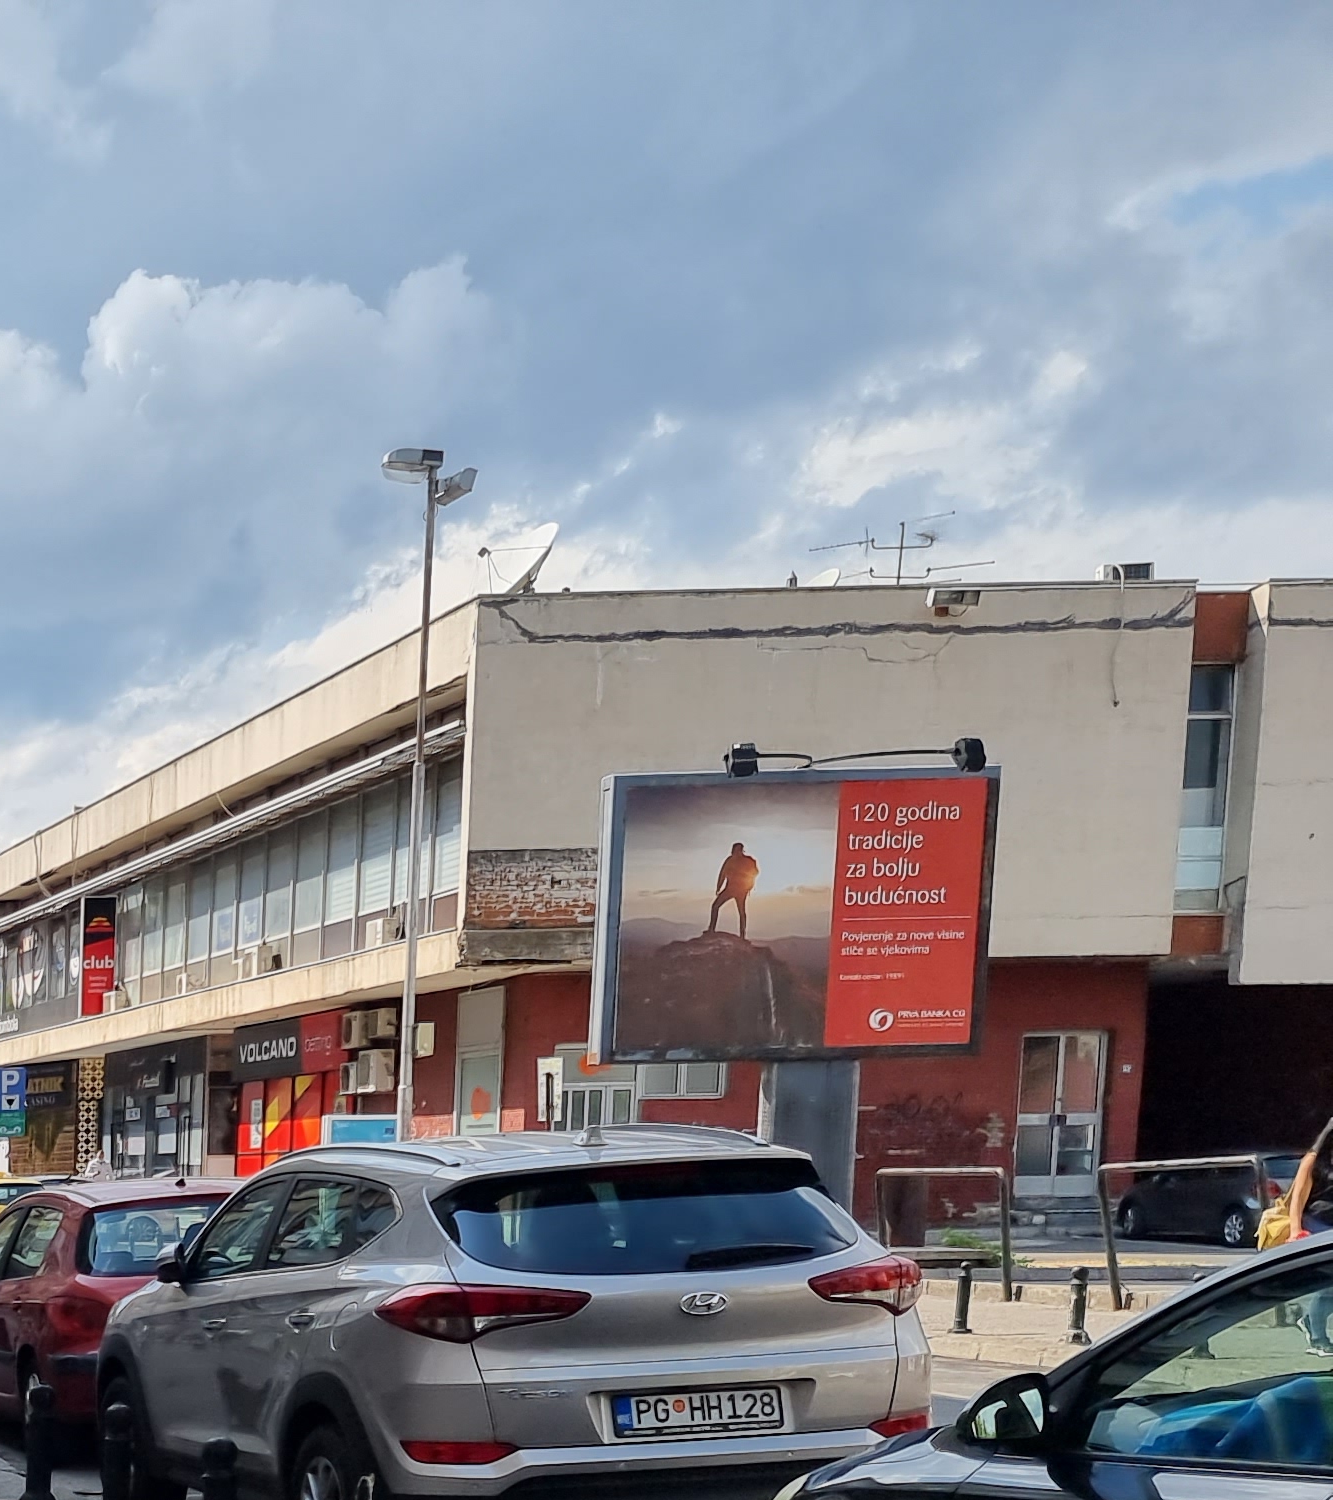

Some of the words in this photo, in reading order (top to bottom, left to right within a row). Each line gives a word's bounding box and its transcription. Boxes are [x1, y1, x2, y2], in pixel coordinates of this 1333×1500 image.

[850, 802, 889, 822] 120
[894, 800, 961, 827] godina
[848, 829, 924, 854] tradicije
[845, 862, 866, 878] za
[872, 857, 920, 882] bolju
[844, 885, 947, 906] budućnost
[841, 930, 894, 943] Povjerenje
[896, 932, 907, 940] za
[909, 931, 934, 940] nove
[936, 929, 965, 940] visine
[83, 955, 114, 969] club
[866, 946, 878, 955] se
[880, 943, 930, 957] vjekovima
[239, 1036, 297, 1064] VOLCANO
[1, 1070, 20, 1094] P
[635, 1397, 670, 1425] PG
[688, 1391, 776, 1422] HH128
